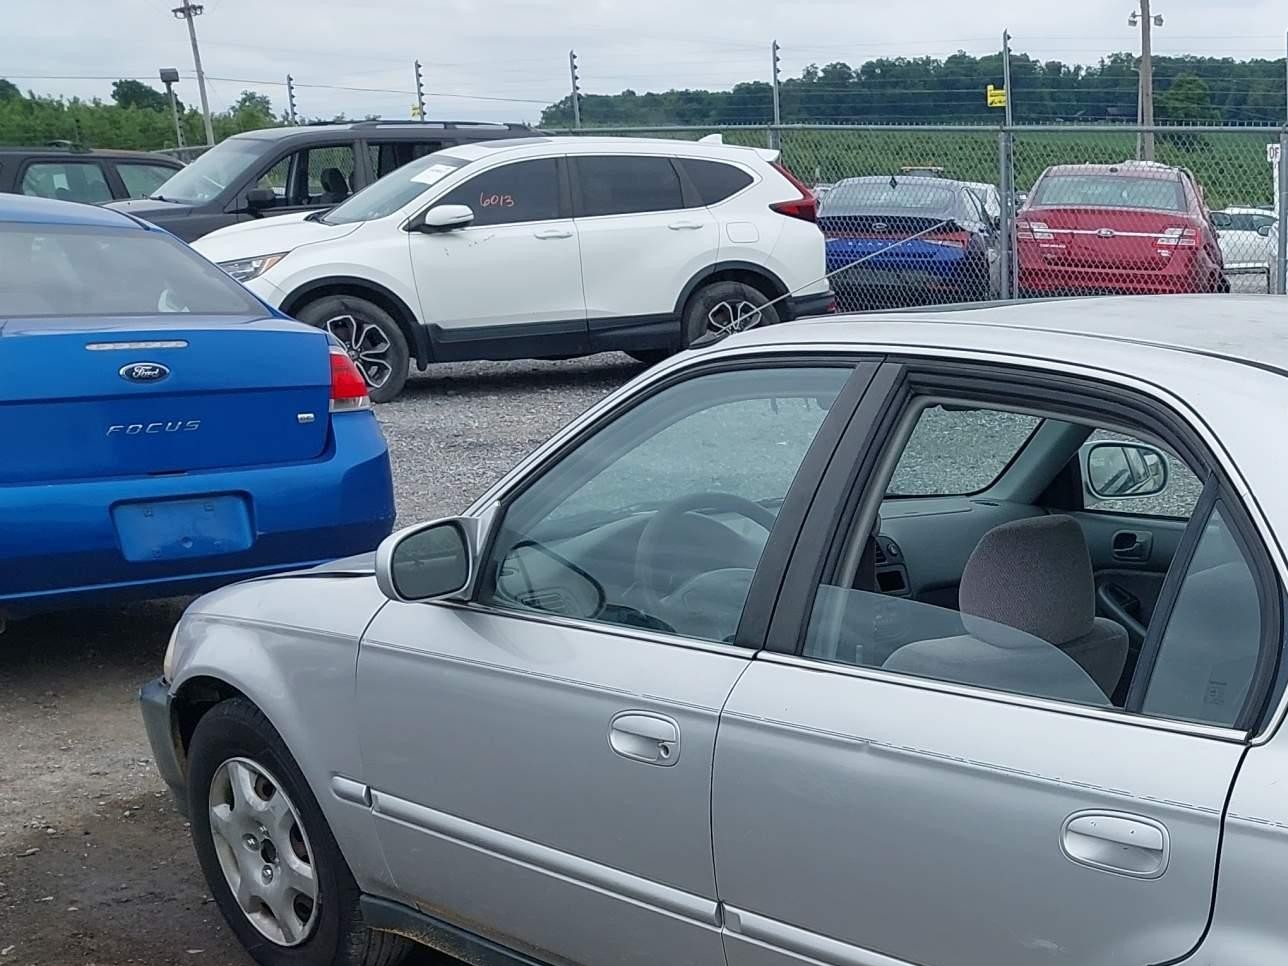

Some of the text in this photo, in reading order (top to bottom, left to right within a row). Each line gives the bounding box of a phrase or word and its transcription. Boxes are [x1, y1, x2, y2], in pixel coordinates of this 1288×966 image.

[480, 191, 515, 207] 6013
[132, 365, 160, 378] Ford
[106, 420, 201, 437] FOCUS
